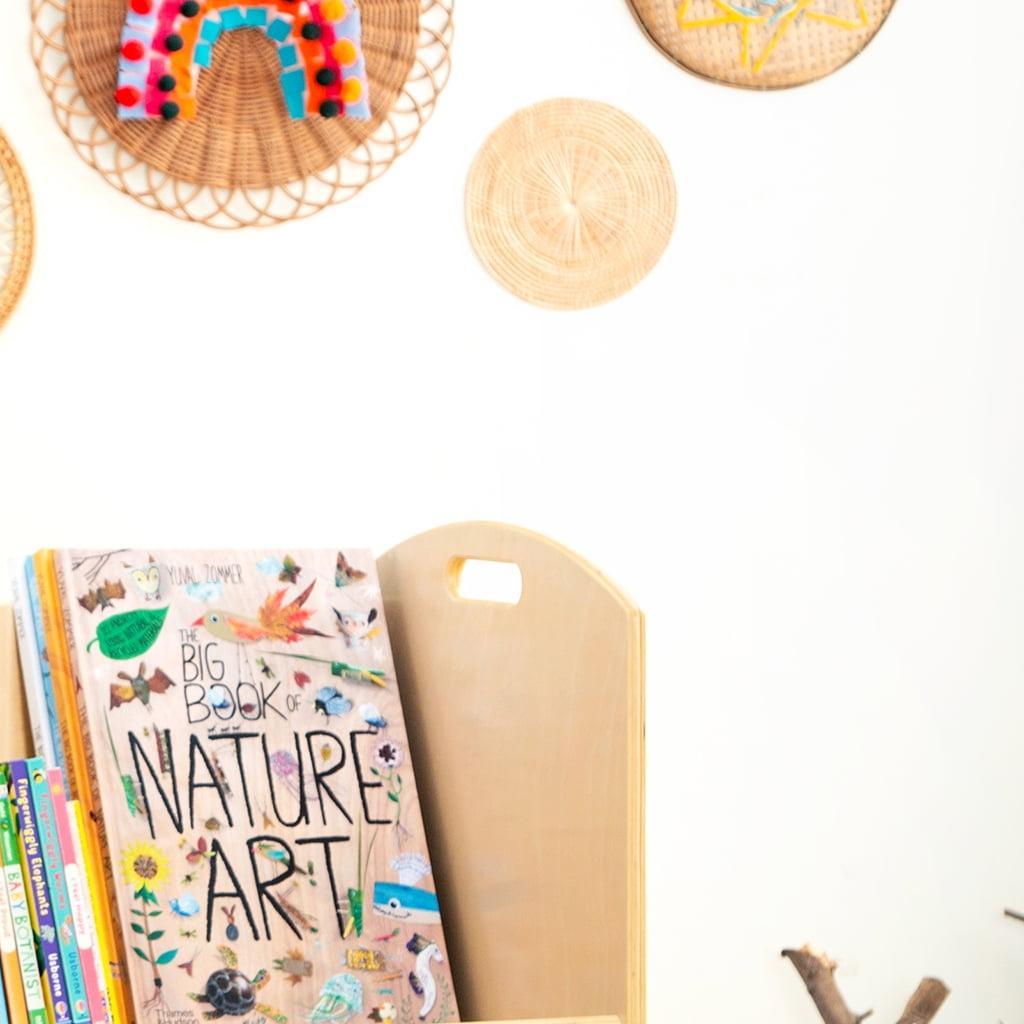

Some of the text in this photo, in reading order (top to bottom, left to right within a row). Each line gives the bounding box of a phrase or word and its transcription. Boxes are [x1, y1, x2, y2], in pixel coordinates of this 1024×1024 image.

[168, 563, 245, 585] YUVAL ZOMMER
[179, 629, 199, 642] THE
[181, 641, 225, 682] BIG
[184, 681, 302, 724] BOOK OF
[128, 727, 393, 840] NATURE
[8, 871, 27, 911] BABY
[17, 778, 63, 998] Fingerwiggly Elephants Usborne
[205, 834, 351, 943] ART
[14, 915, 41, 1001] BOTANIST
[67, 951, 82, 995] Usborne
